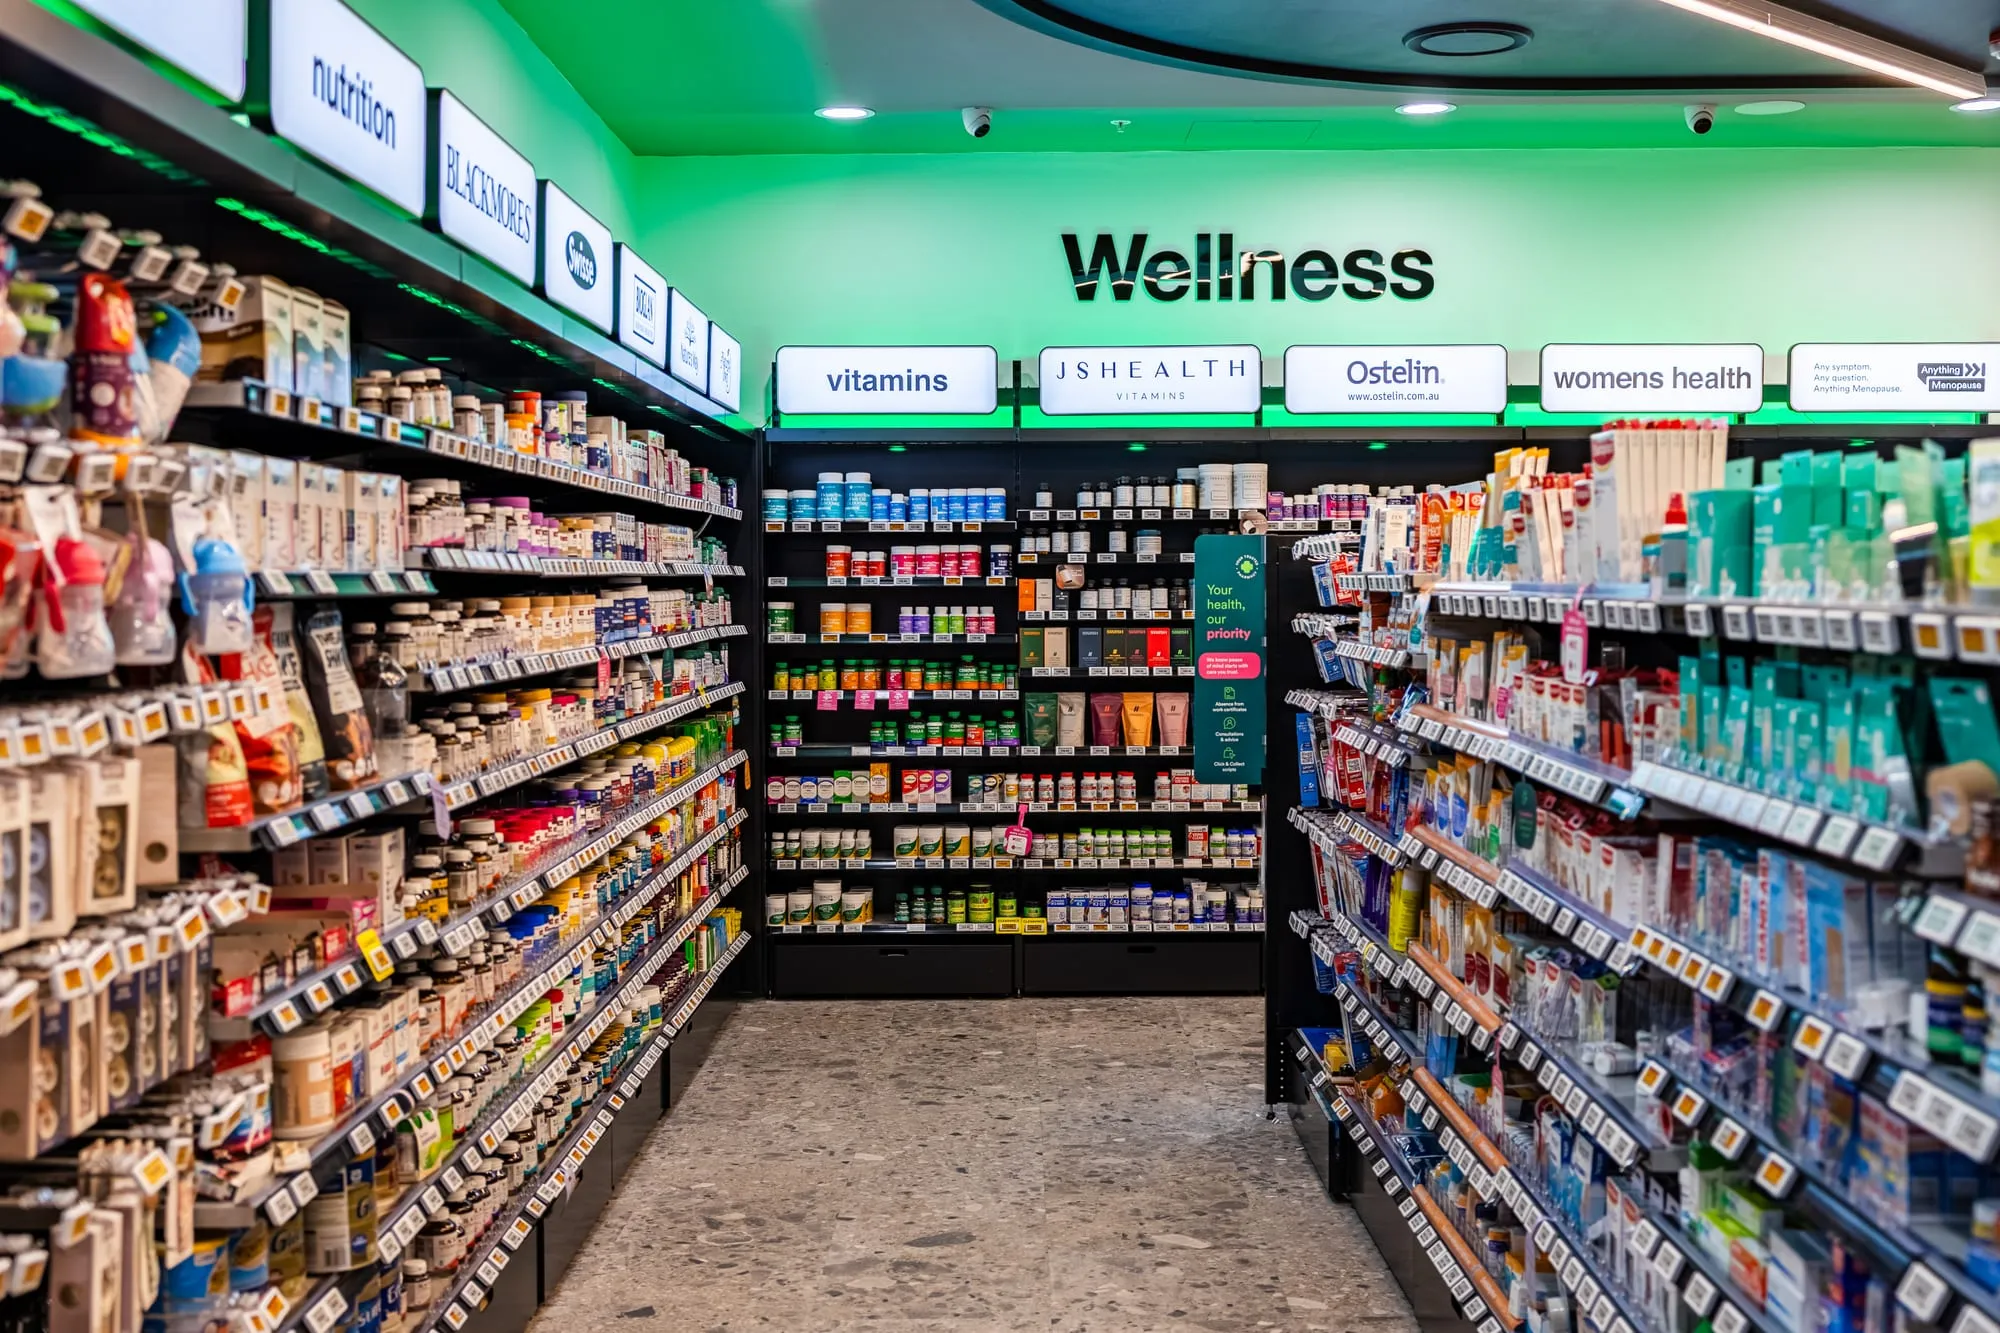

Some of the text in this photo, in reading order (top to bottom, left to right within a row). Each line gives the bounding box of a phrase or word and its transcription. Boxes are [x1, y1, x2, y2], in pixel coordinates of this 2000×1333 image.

[312, 53, 397, 149] nutrition
[445, 142, 531, 246] BLACKMORES
[567, 234, 595, 286] Swisse
[1061, 233, 1435, 302] Wellness
[1813, 362, 1872, 373] Any symptom.
[1920, 365, 1961, 377] Anything
[826, 368, 948, 392] vitamins
[1553, 366, 1752, 390] womens health
[1813, 374, 1869, 384] Any question.
[1813, 384, 1902, 395] Anything Menopause.
[1931, 380, 1982, 392] Menopause
[1116, 391, 1185, 401] VITAMINS
[1347, 390, 1440, 401] www.ostelin.com.au
[1206, 584, 1233, 596] Your
[1206, 598, 1246, 612] health,
[1206, 616, 1227, 625] our
[1206, 628, 1251, 641] priority
